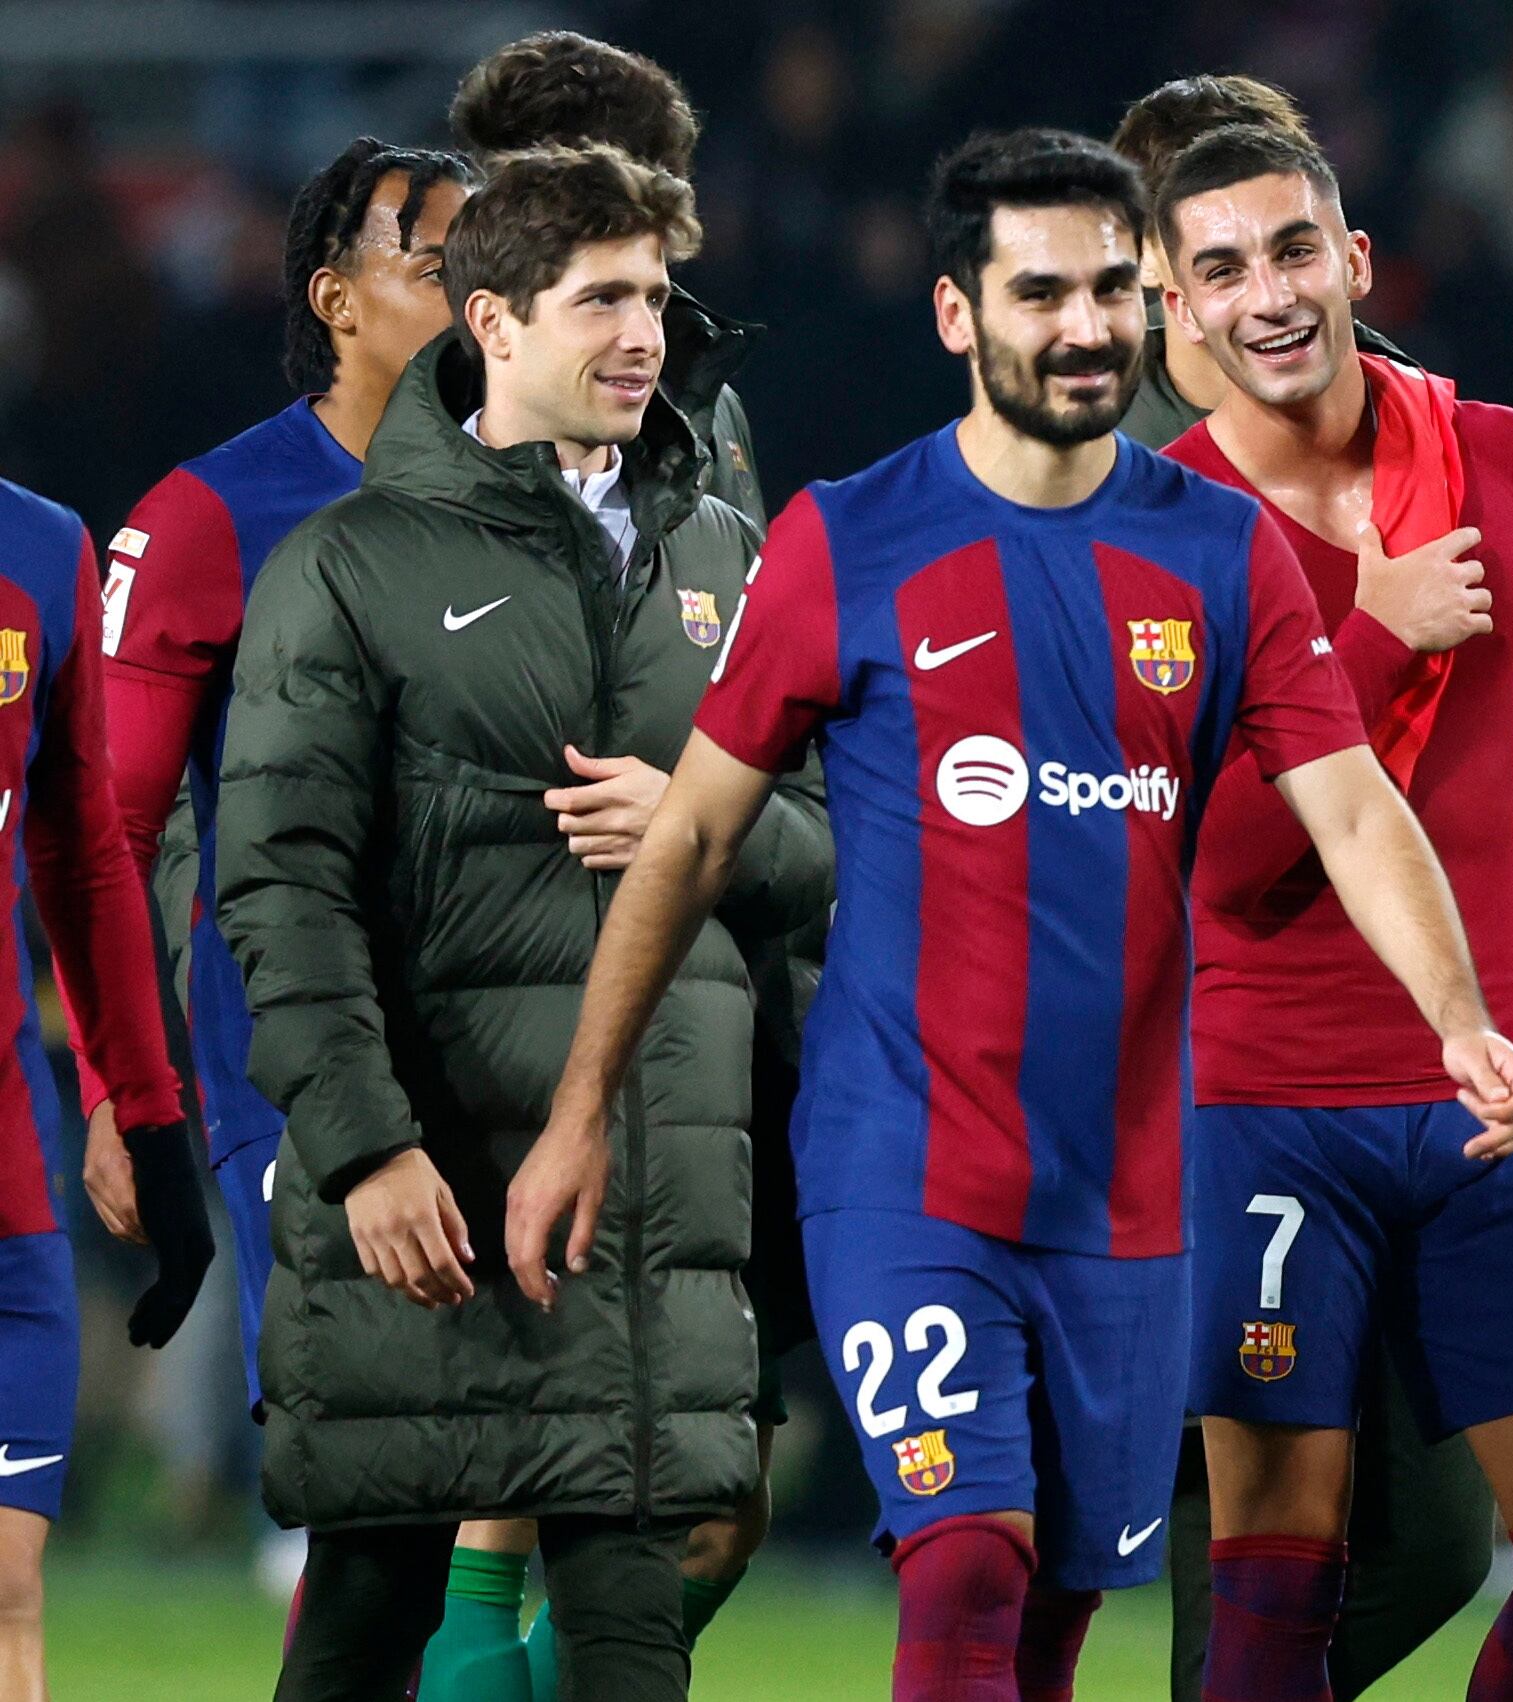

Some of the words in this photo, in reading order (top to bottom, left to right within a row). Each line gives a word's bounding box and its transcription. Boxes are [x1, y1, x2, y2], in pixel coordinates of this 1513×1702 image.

[1039, 761, 1180, 821] Spotify
[1245, 1194, 1305, 1309] 7
[842, 1304, 980, 1439] 22
